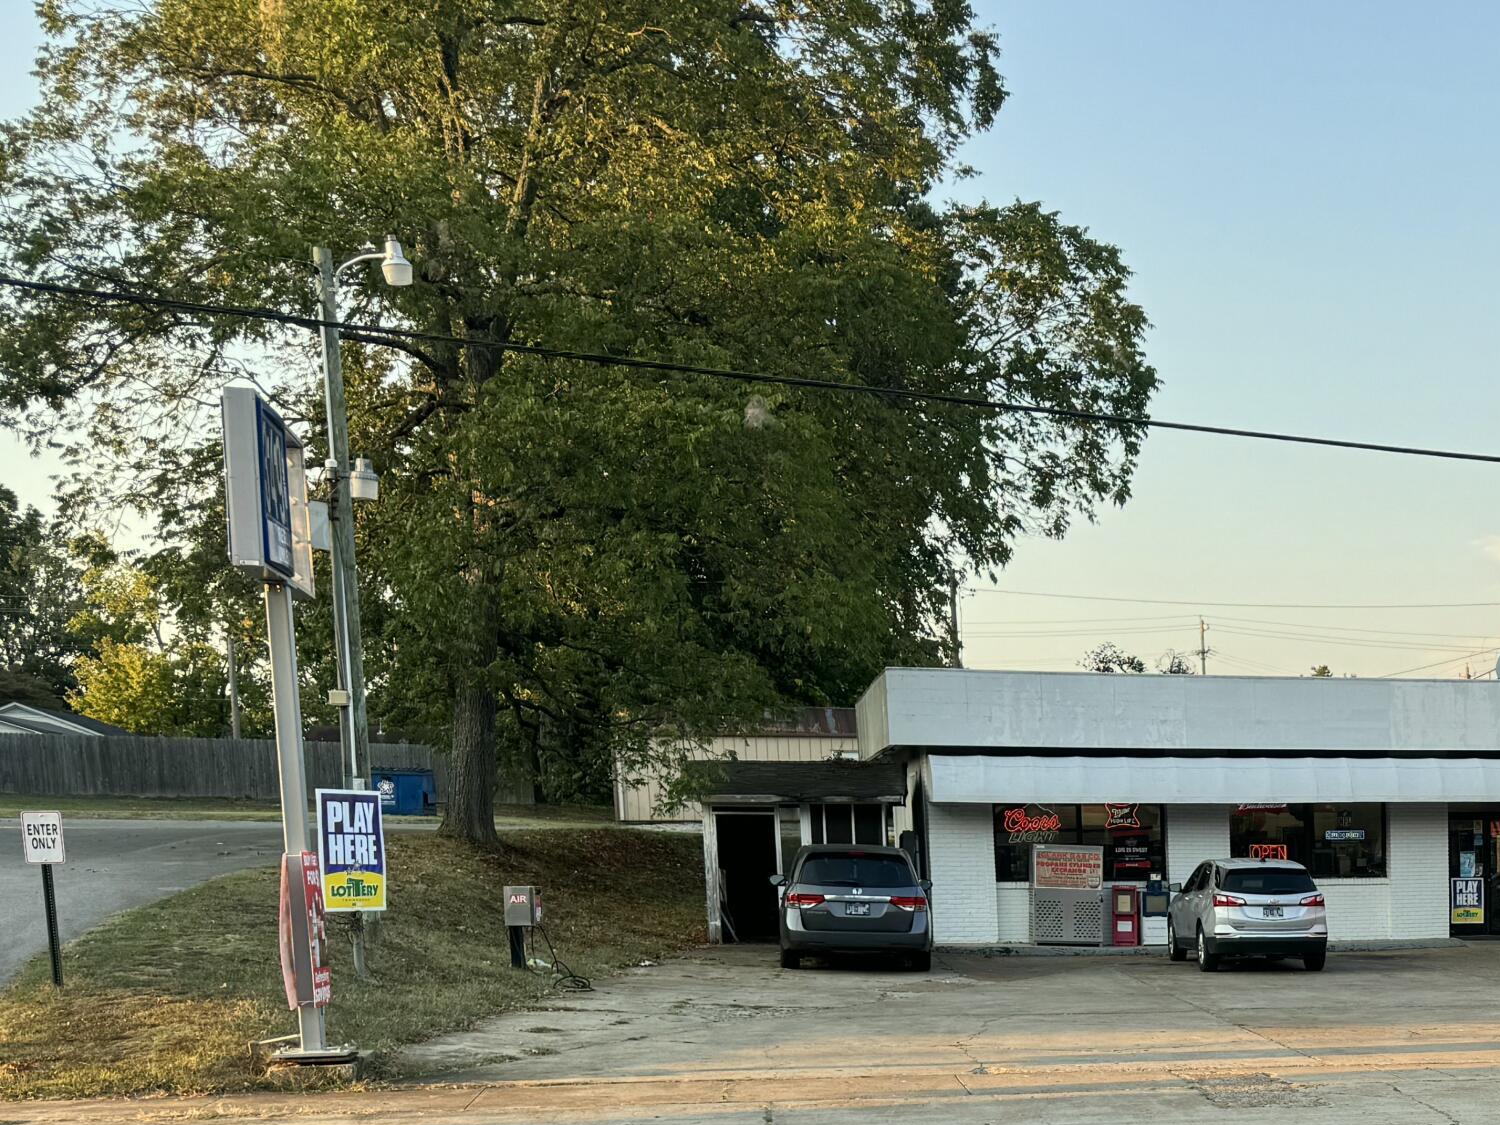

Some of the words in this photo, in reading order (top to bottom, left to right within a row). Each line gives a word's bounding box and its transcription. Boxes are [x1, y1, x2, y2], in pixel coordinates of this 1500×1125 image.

[326, 801, 374, 833] PLAY
[1004, 808, 1061, 832] Coors
[27, 823, 58, 836] ENTER
[32, 837, 56, 849] ONLY
[1009, 831, 1058, 844] LIGHT
[328, 834, 377, 865] HERE
[1252, 847, 1286, 860] OPEN
[331, 878, 378, 897] LOTTERY
[1456, 881, 1478, 894] PLAY
[510, 895, 527, 904] AIR
[1457, 894, 1478, 906] HERE
